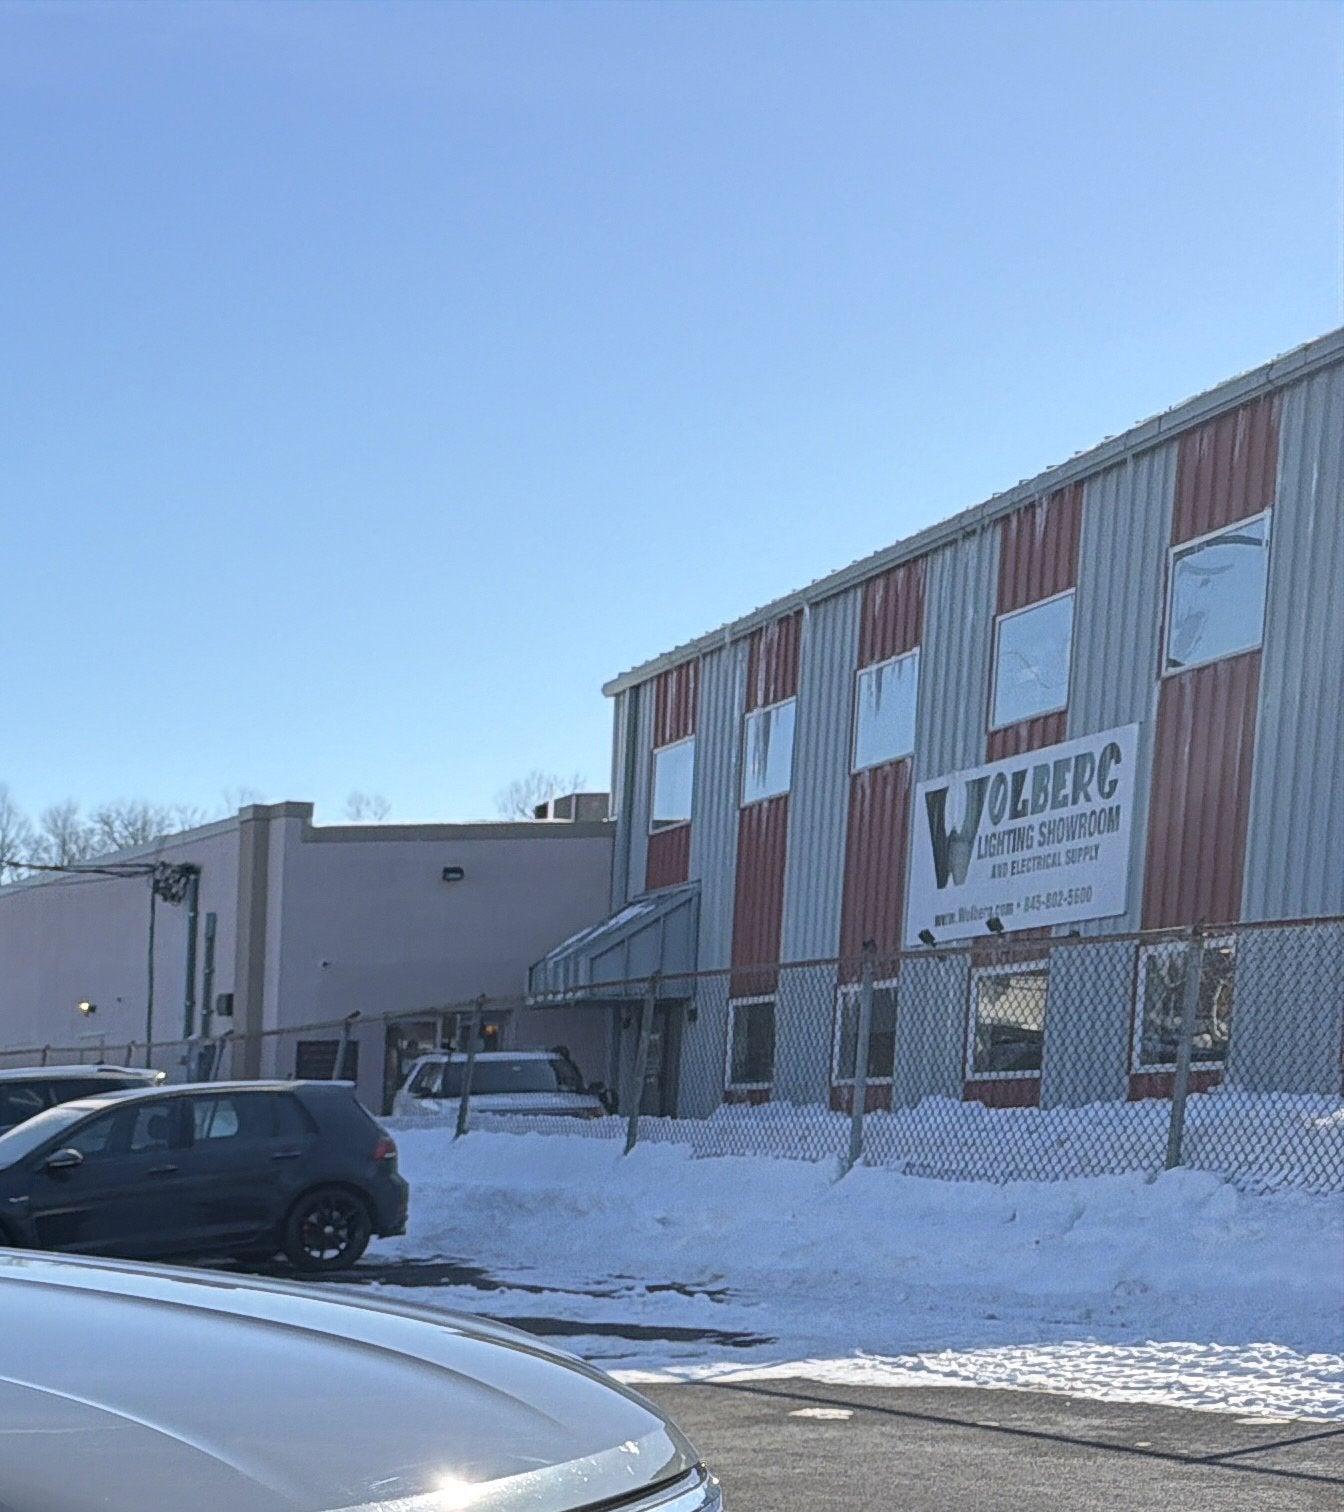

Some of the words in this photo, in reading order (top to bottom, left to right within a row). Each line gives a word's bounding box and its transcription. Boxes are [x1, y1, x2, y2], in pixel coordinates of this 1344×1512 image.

[924, 742, 1122, 890] WOLBERG
[976, 824, 1034, 860] LIGHTING
[1037, 804, 1121, 847] SHOWROOM
[990, 862, 1009, 879] AND
[1011, 851, 1062, 876] ELECTRICAL
[1065, 844, 1100, 866] SUPPLY
